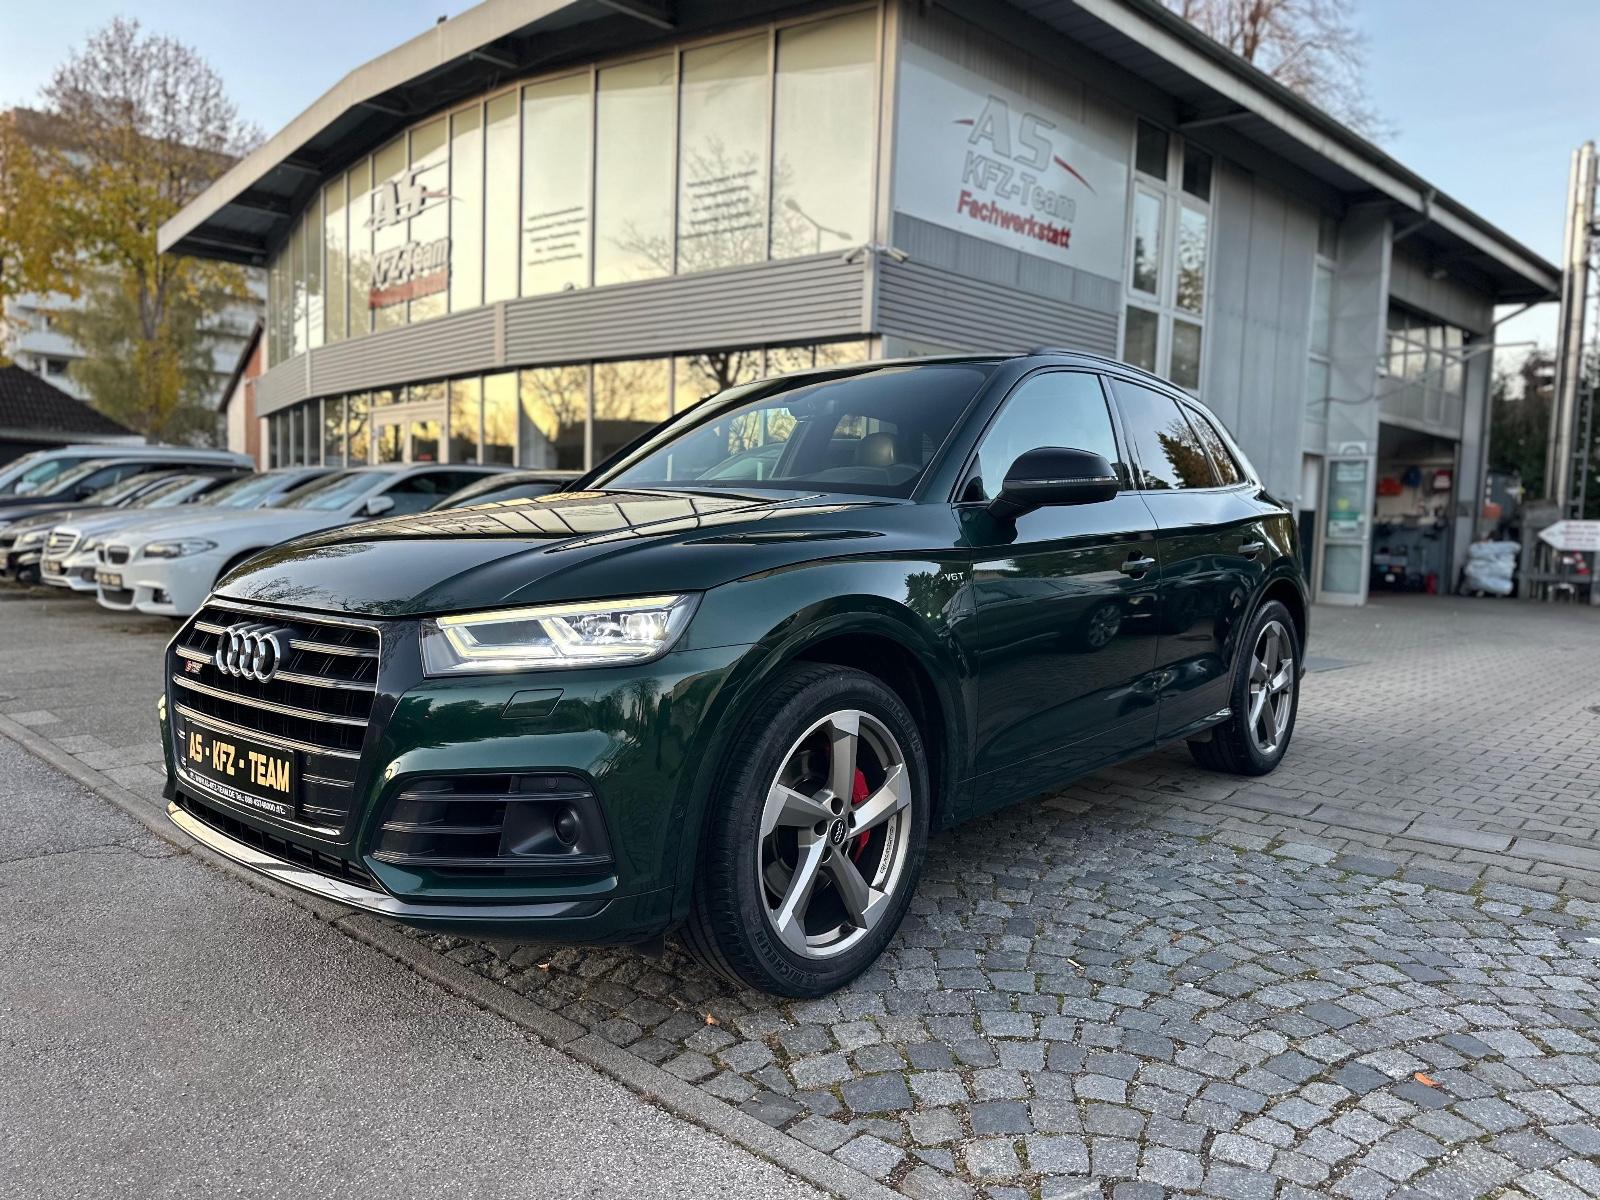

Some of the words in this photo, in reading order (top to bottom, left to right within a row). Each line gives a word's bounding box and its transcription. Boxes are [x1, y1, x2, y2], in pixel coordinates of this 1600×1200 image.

[967, 94, 1057, 173] AS
[957, 190, 1072, 250] Fachwerkstatt
[961, 150, 1077, 224] KFZ-Team
[189, 731, 203, 763] AS
[212, 739, 236, 776] KFZ
[248, 751, 290, 793] TEAM
